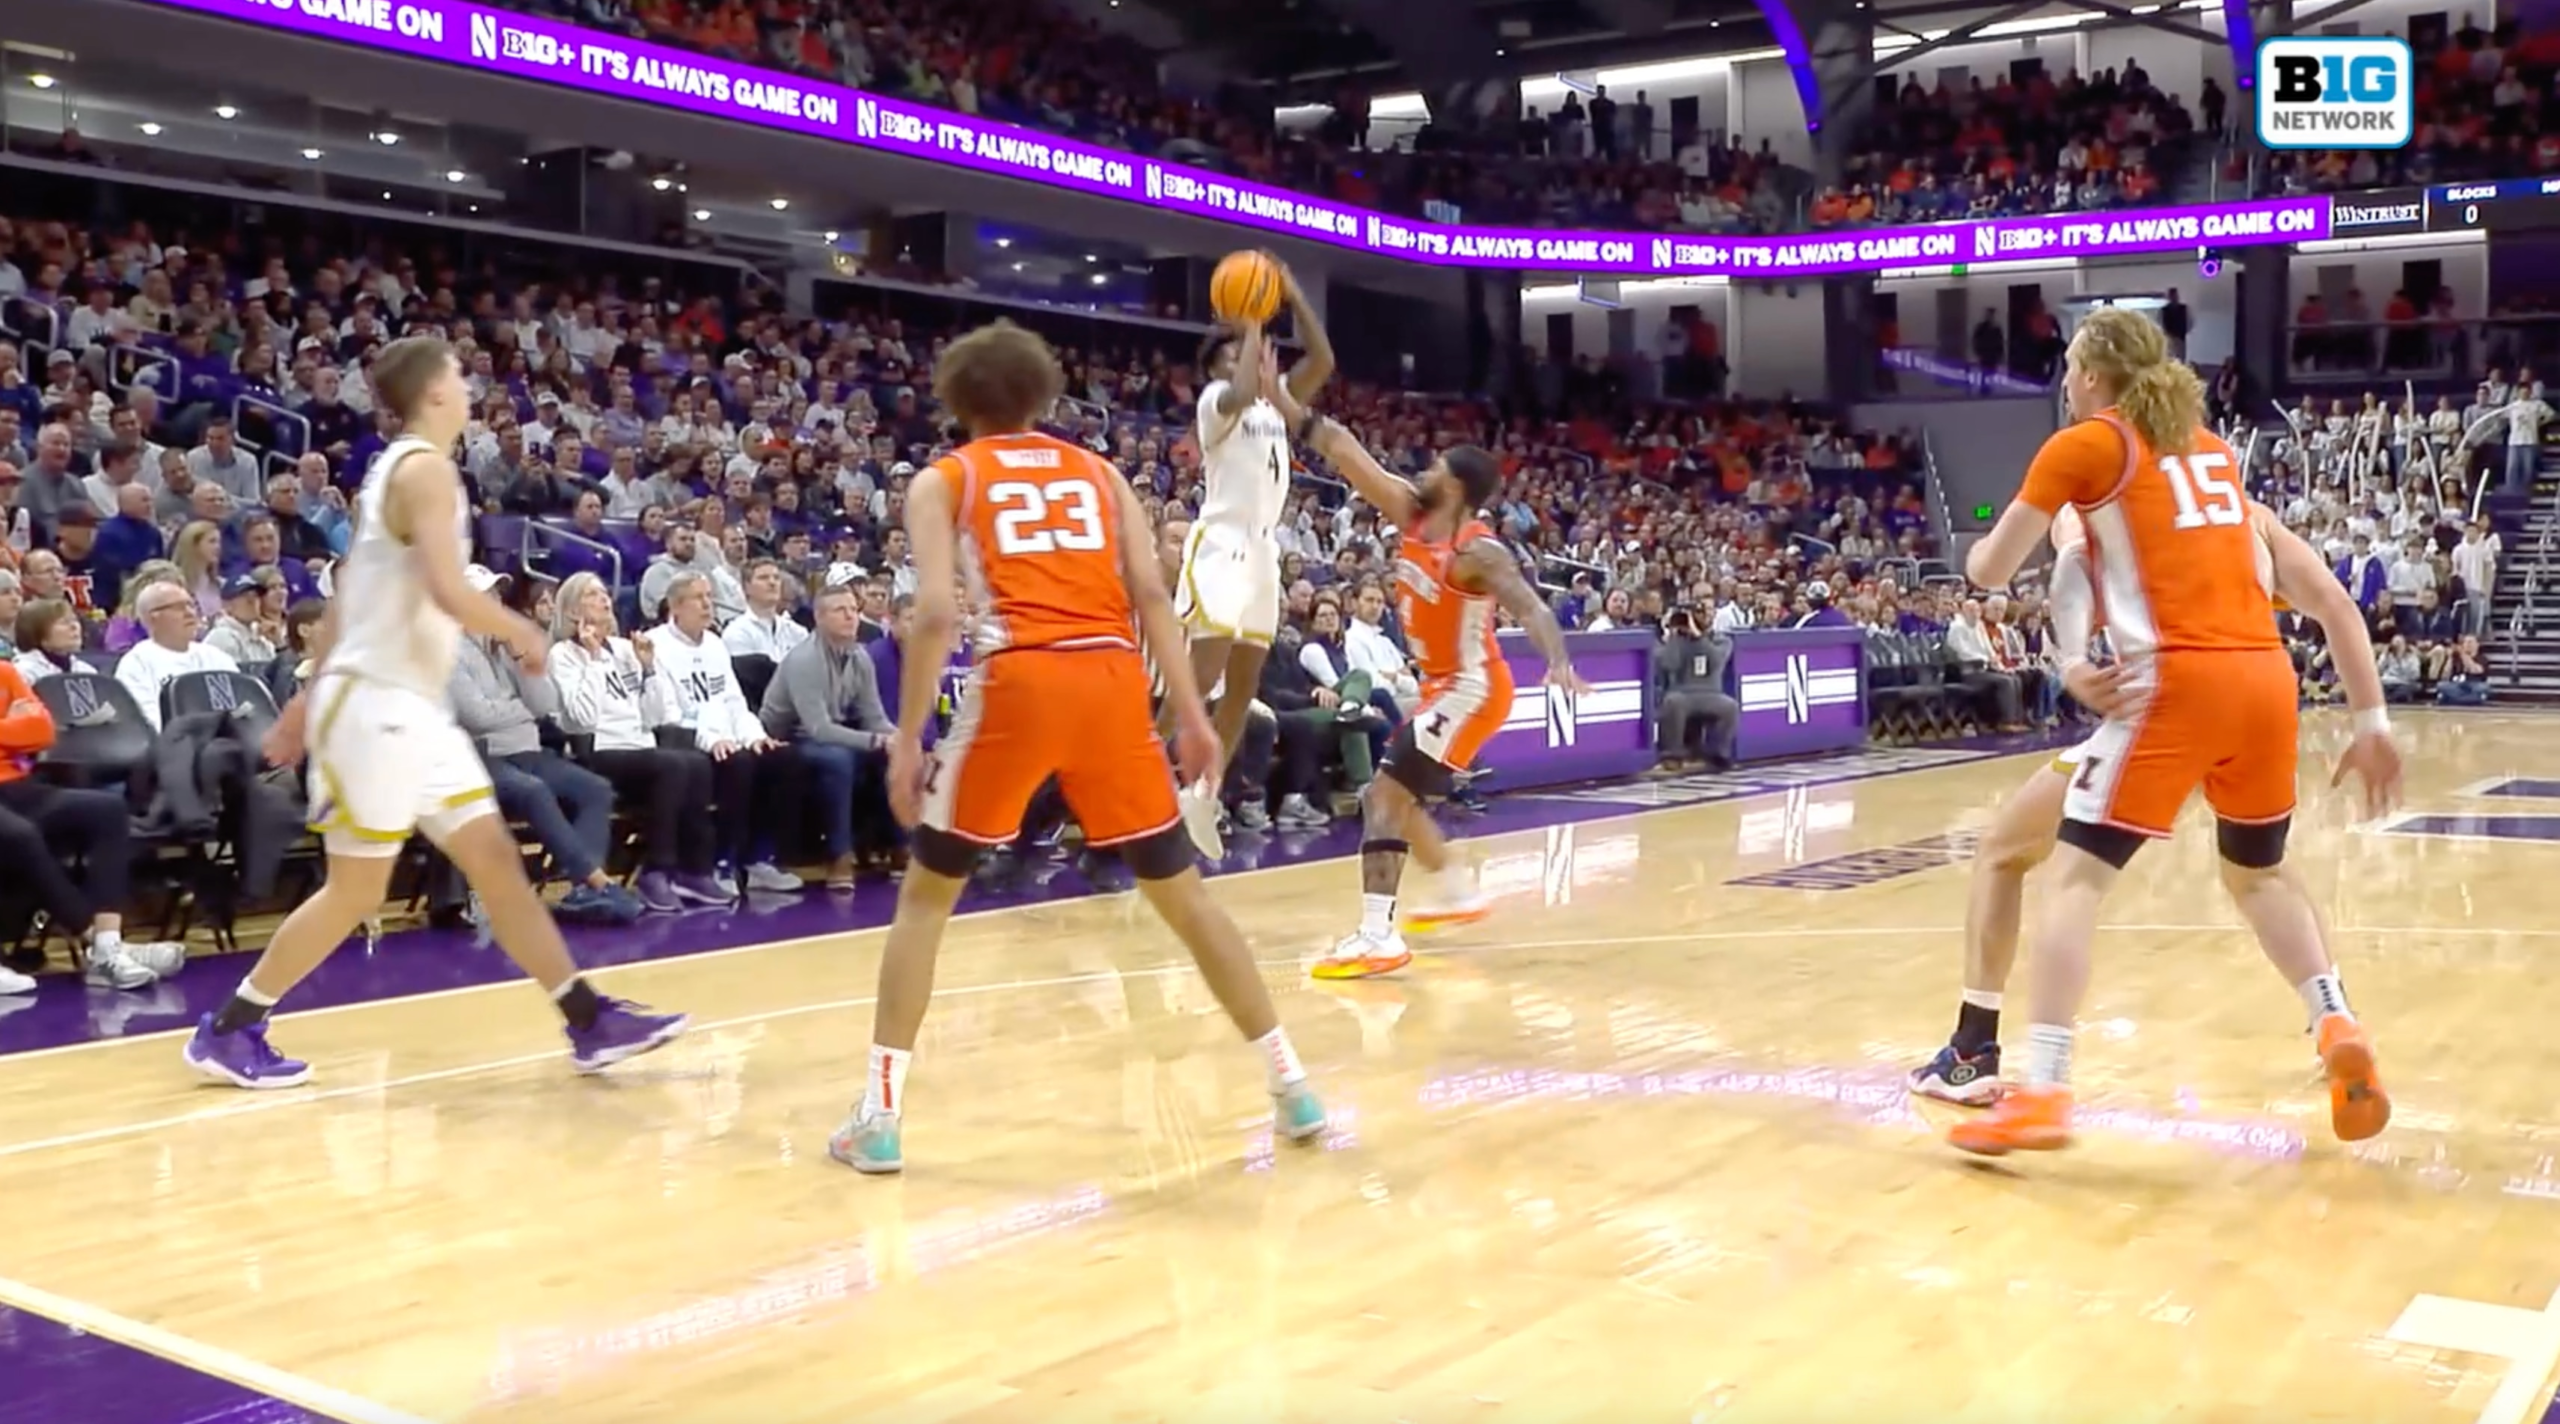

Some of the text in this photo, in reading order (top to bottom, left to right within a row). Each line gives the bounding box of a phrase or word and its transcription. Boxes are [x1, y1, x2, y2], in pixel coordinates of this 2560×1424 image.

[396, 5, 443, 42] ON
[581, 45, 629, 79] IT'S
[632, 57, 730, 100] ALWAYS
[733, 79, 801, 116] GAME
[803, 94, 838, 124] ON
[938, 124, 974, 153] IT'S
[977, 133, 1051, 169] ALWAYS
[1053, 150, 1104, 181] GAME
[1105, 162, 1132, 187] ON
[1207, 184, 1236, 209] IT'S
[1238, 192, 1294, 222] ALWAYS
[1296, 205, 1336, 232] GAME
[1336, 214, 1358, 237] ON
[2447, 186, 2497, 201] BLOCKS
[2061, 224, 2105, 246] IT'S
[2105, 217, 2199, 243] ALWAYS
[2202, 211, 2273, 237] GAME
[2275, 209, 2315, 231] ON
[2465, 205, 2478, 223] 0
[1418, 233, 1449, 254] IT'S
[1450, 236, 1534, 258] ALWAYS
[1536, 240, 1599, 260] GAME
[1600, 242, 1634, 261] ON
[1733, 246, 1773, 266] IT'S
[1774, 242, 1855, 265] ALWAYS
[1858, 237, 1921, 260] GAME
[1921, 235, 1955, 255] ON
[1267, 442, 1280, 484] 4
[2158, 453, 2245, 529] 15
[988, 479, 1106, 555] 23
[204, 673, 237, 711] N
[1787, 655, 1808, 724] N
